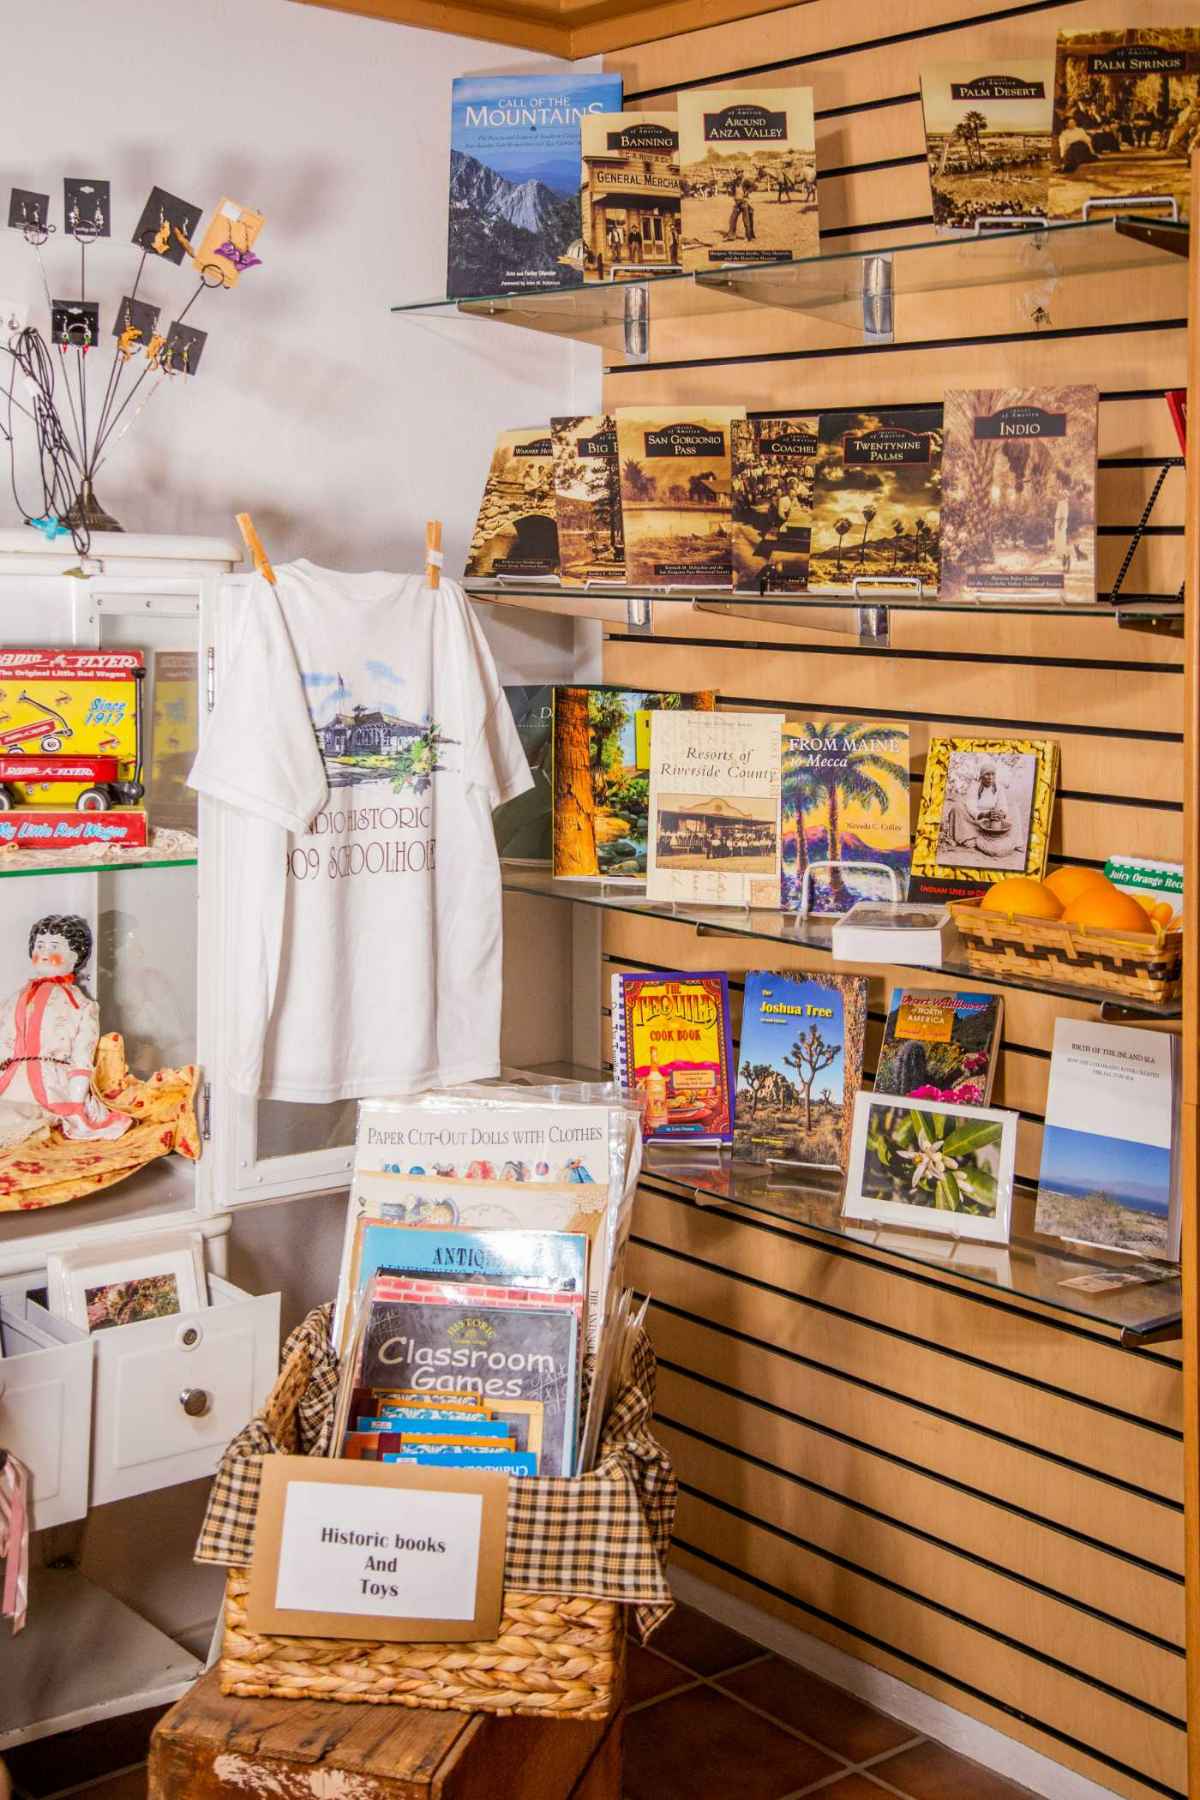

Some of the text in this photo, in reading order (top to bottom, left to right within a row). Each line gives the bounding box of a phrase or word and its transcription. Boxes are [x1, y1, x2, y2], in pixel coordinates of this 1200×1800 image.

[1093, 58, 1181, 70] PALM SPRINGS
[960, 86, 1038, 97] PALM DESERT
[498, 95, 570, 109] CALL OF THE
[465, 102, 604, 127] MOUNTAINS
[725, 117, 767, 127] AROUND
[709, 127, 783, 139] ANZA VALLEY
[621, 135, 673, 147] BANNING
[596, 170, 641, 185] GENERAL
[1000, 421, 1041, 436] INDIO
[648, 434, 721, 445] SAN GORGONIO
[854, 440, 921, 451] TWENTYNINE
[588, 442, 609, 454] BIG
[674, 445, 697, 455] PASS
[771, 443, 817, 454] COACHEL
[870, 450, 904, 461] PALMS
[75, 655, 140, 668] FLYER
[15, 669, 50, 678] Original
[96, 671, 127, 679] Wagon
[91, 697, 128, 711] Since
[85, 712, 125, 726] 1917
[789, 737, 900, 753] FROM MAINE
[686, 747, 755, 765] Resorts of
[791, 754, 849, 768] to Mecca
[661, 763, 777, 783] Riverside County
[18, 821, 53, 839] Little
[53, 822, 85, 838] Red
[82, 822, 128, 841] Wagon
[1110, 869, 1130, 881] Juicy
[1132, 872, 1163, 888] Orange
[665, 982, 681, 995] THE
[760, 1001, 834, 1018] Joshua Tree
[918, 1007, 943, 1015] NORTH
[907, 1015, 945, 1025] AMERICA
[650, 1029, 702, 1042] COOK BOOK
[1072, 1042, 1156, 1065] BIRTH OF THE INLAND SEA
[367, 1125, 603, 1146] PAPER CUT-OUT DOLLS WITH CLOTHES
[432, 1246, 487, 1270] ANTIQ
[447, 1318, 497, 1338] HISTORIC
[378, 1336, 555, 1373] Classroom
[411, 1366, 523, 1398] Games
[320, 1526, 447, 1553] Historic books
[364, 1555, 398, 1573] And
[360, 1578, 399, 1600] Toys
